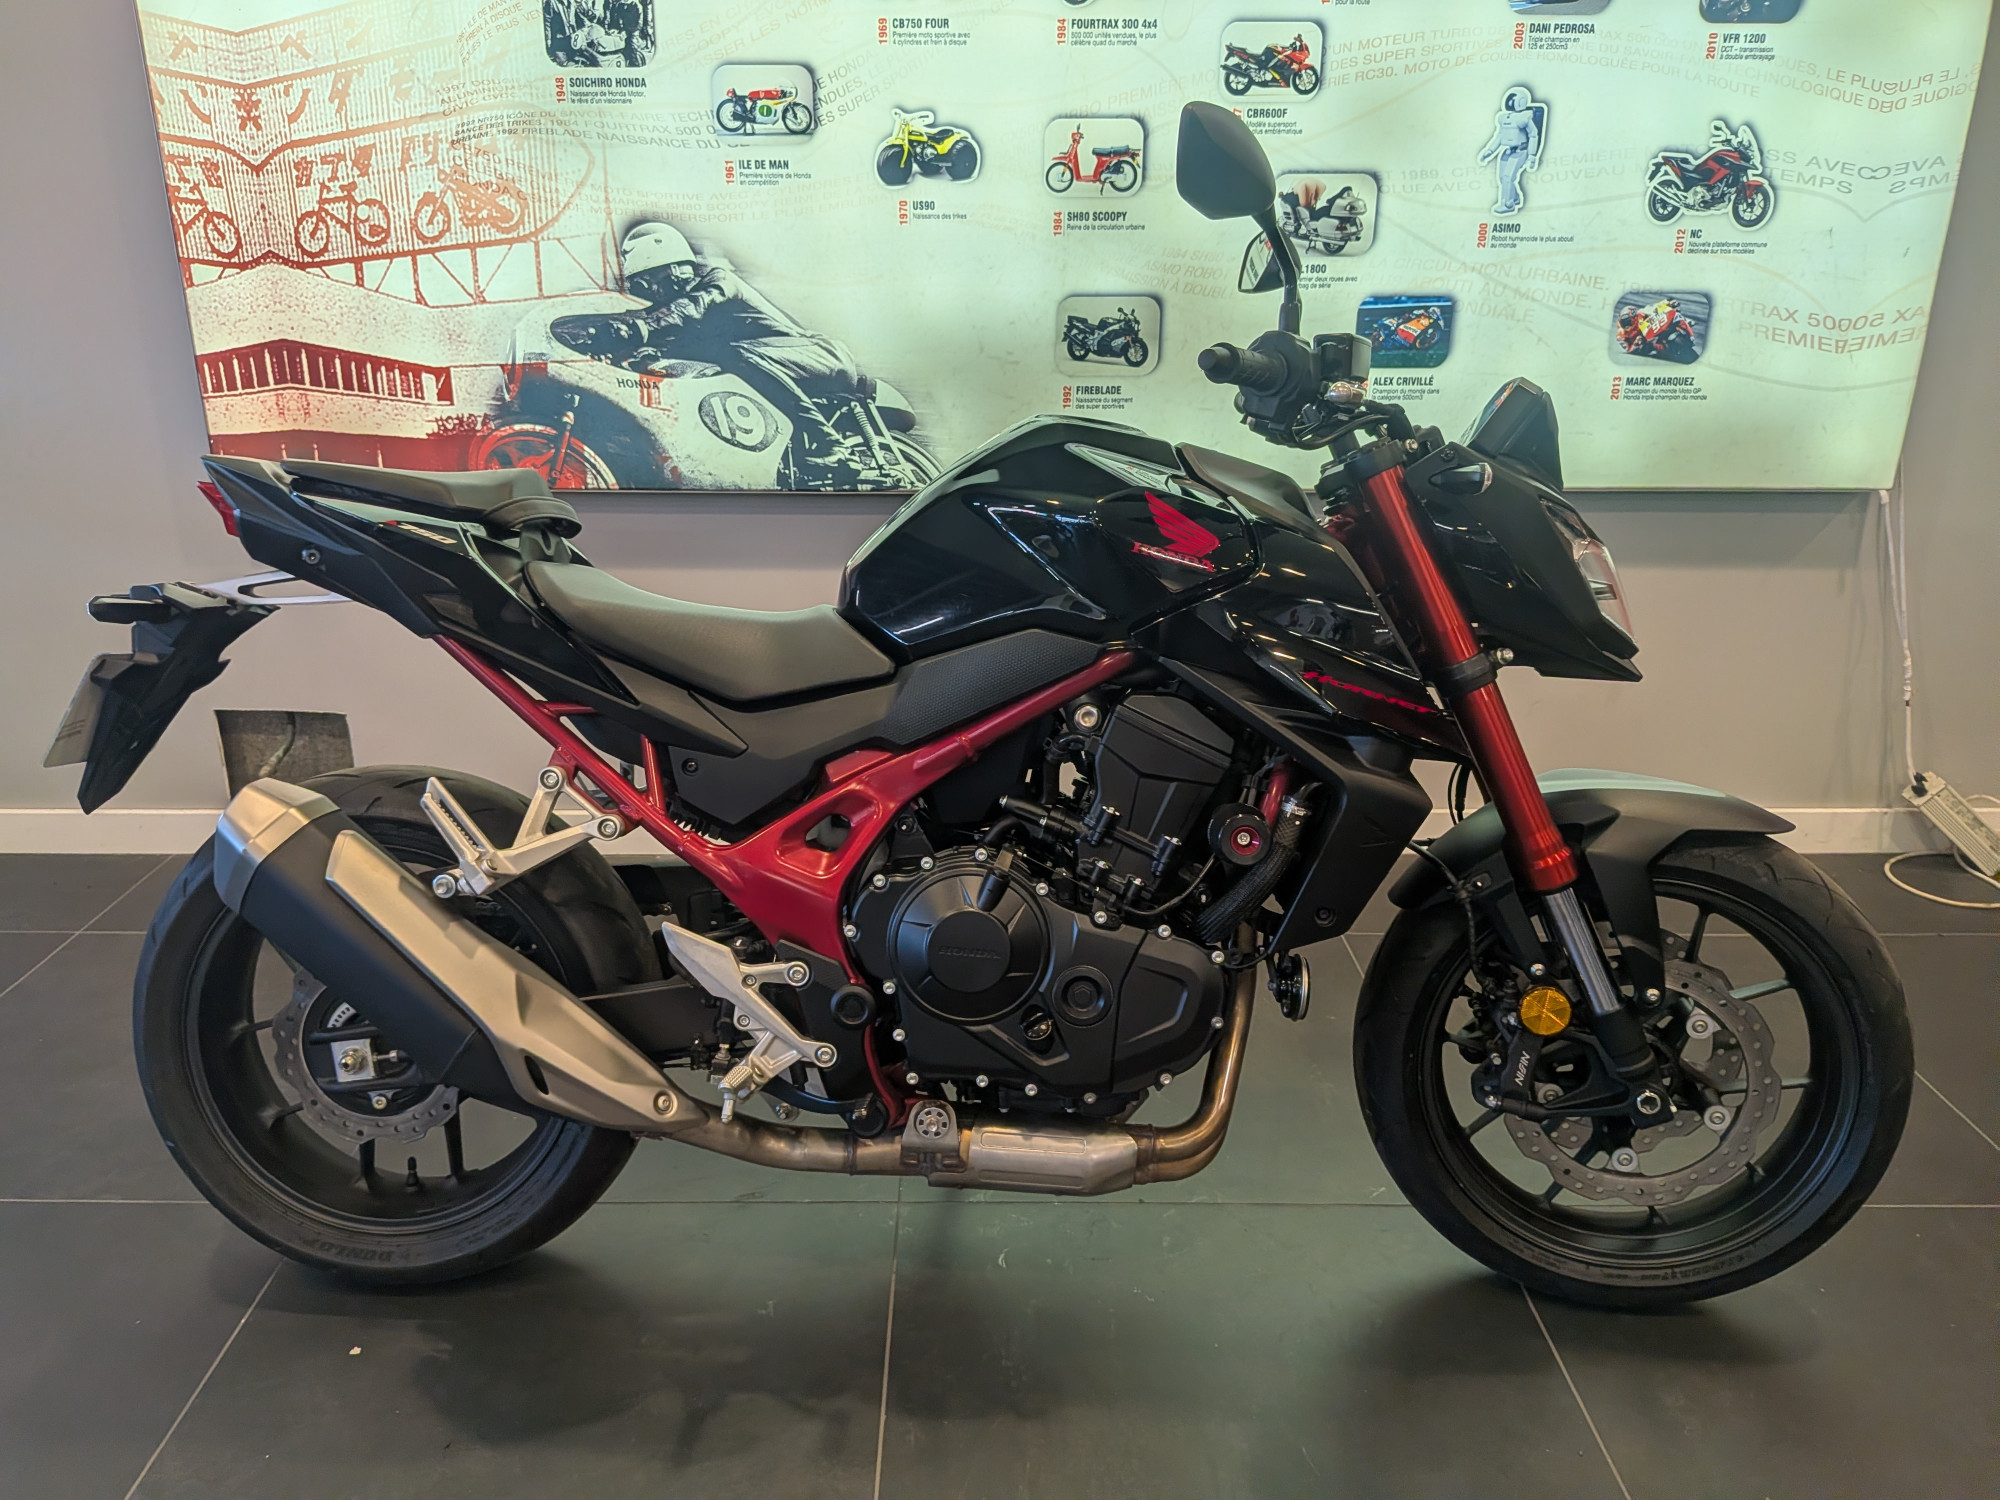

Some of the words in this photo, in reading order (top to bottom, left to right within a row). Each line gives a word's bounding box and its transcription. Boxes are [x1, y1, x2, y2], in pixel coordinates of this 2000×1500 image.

[490, 2, 523, 24] DISQUE
[496, 18, 521, 33] PLUS
[878, 17, 888, 45] 1969
[892, 18, 922, 29] CB750
[925, 18, 949, 29] FOUR
[1057, 18, 1066, 45] 1984
[1071, 18, 1119, 30] FOURTRAX
[1121, 18, 1139, 30] 300
[1141, 18, 1158, 30] 4x4
[1529, 23, 1551, 34] DANI
[1553, 23, 1595, 34] PEDROSA
[893, 31, 917, 39] Première
[919, 31, 933, 39] moto
[934, 31, 956, 39] sportive
[958, 31, 971, 39] avec
[1071, 32, 1081, 40] 500
[1083, 32, 1094, 40] 000
[1094, 32, 1111, 40] unités
[1112, 32, 1137, 40] vendues,
[1145, 32, 1157, 40] plus
[1357, 32, 1426, 52] MOTEUR
[1513, 22, 1525, 50] 2003
[1528, 35, 1543, 43] Triple
[1544, 35, 1571, 43] champion
[1722, 33, 1741, 44] VFR
[1743, 33, 1767, 44] 1200
[1705, 32, 1719, 60] 2010
[1720, 45, 1734, 53] DCT
[1329, 57, 1359, 73] DES
[1362, 49, 1417, 67] SUPER
[569, 77, 612, 88] SOICHIRO
[615, 77, 647, 88] HONDA
[1354, 70, 1399, 83] RC30.
[1403, 58, 1451, 75] MOTO
[1454, 55, 1473, 68] DE
[1640, 62, 1680, 79] POUR
[1684, 70, 1702, 82] LA
[1706, 74, 1761, 99] ROUTE
[1826, 67, 1847, 84] LE
[555, 77, 566, 104] 1948
[570, 90, 598, 98] Naissance
[608, 90, 626, 98] Honda
[628, 90, 646, 98] Motor,
[840, 86, 881, 117] SUPER
[1246, 108, 1288, 119] CBR600F
[522, 127, 593, 140] FIREBLADE
[597, 131, 692, 150] NAISSANCE
[696, 139, 720, 150] DU
[725, 160, 735, 184] 1961
[738, 160, 752, 170] ILE
[755, 160, 766, 170] DE
[769, 160, 789, 170] MAN
[899, 200, 908, 226] 1970
[912, 200, 935, 211] US90
[1053, 211, 1063, 236] 1984
[1067, 211, 1090, 222] SH80
[1092, 211, 1127, 222] SCOOPY
[1477, 222, 1488, 248] 2000
[1492, 223, 1521, 233] ASIMO
[1690, 228, 1703, 239] NC
[1674, 228, 1686, 254] 2012
[1514, 286, 1592, 310] MONDE.
[1076, 385, 1123, 395] FIREBLADE
[1372, 377, 1395, 386] ALEX
[1396, 374, 1434, 386] CRIVILLÉ
[1610, 376, 1622, 400] 2013
[1625, 376, 1651, 387] MARC
[1652, 376, 1695, 387] MARQUEZ
[1062, 385, 1072, 410] 1992
[711, 395, 767, 444] 19
[397, 522, 457, 544] 750
[1131, 541, 1216, 573] HONDA
